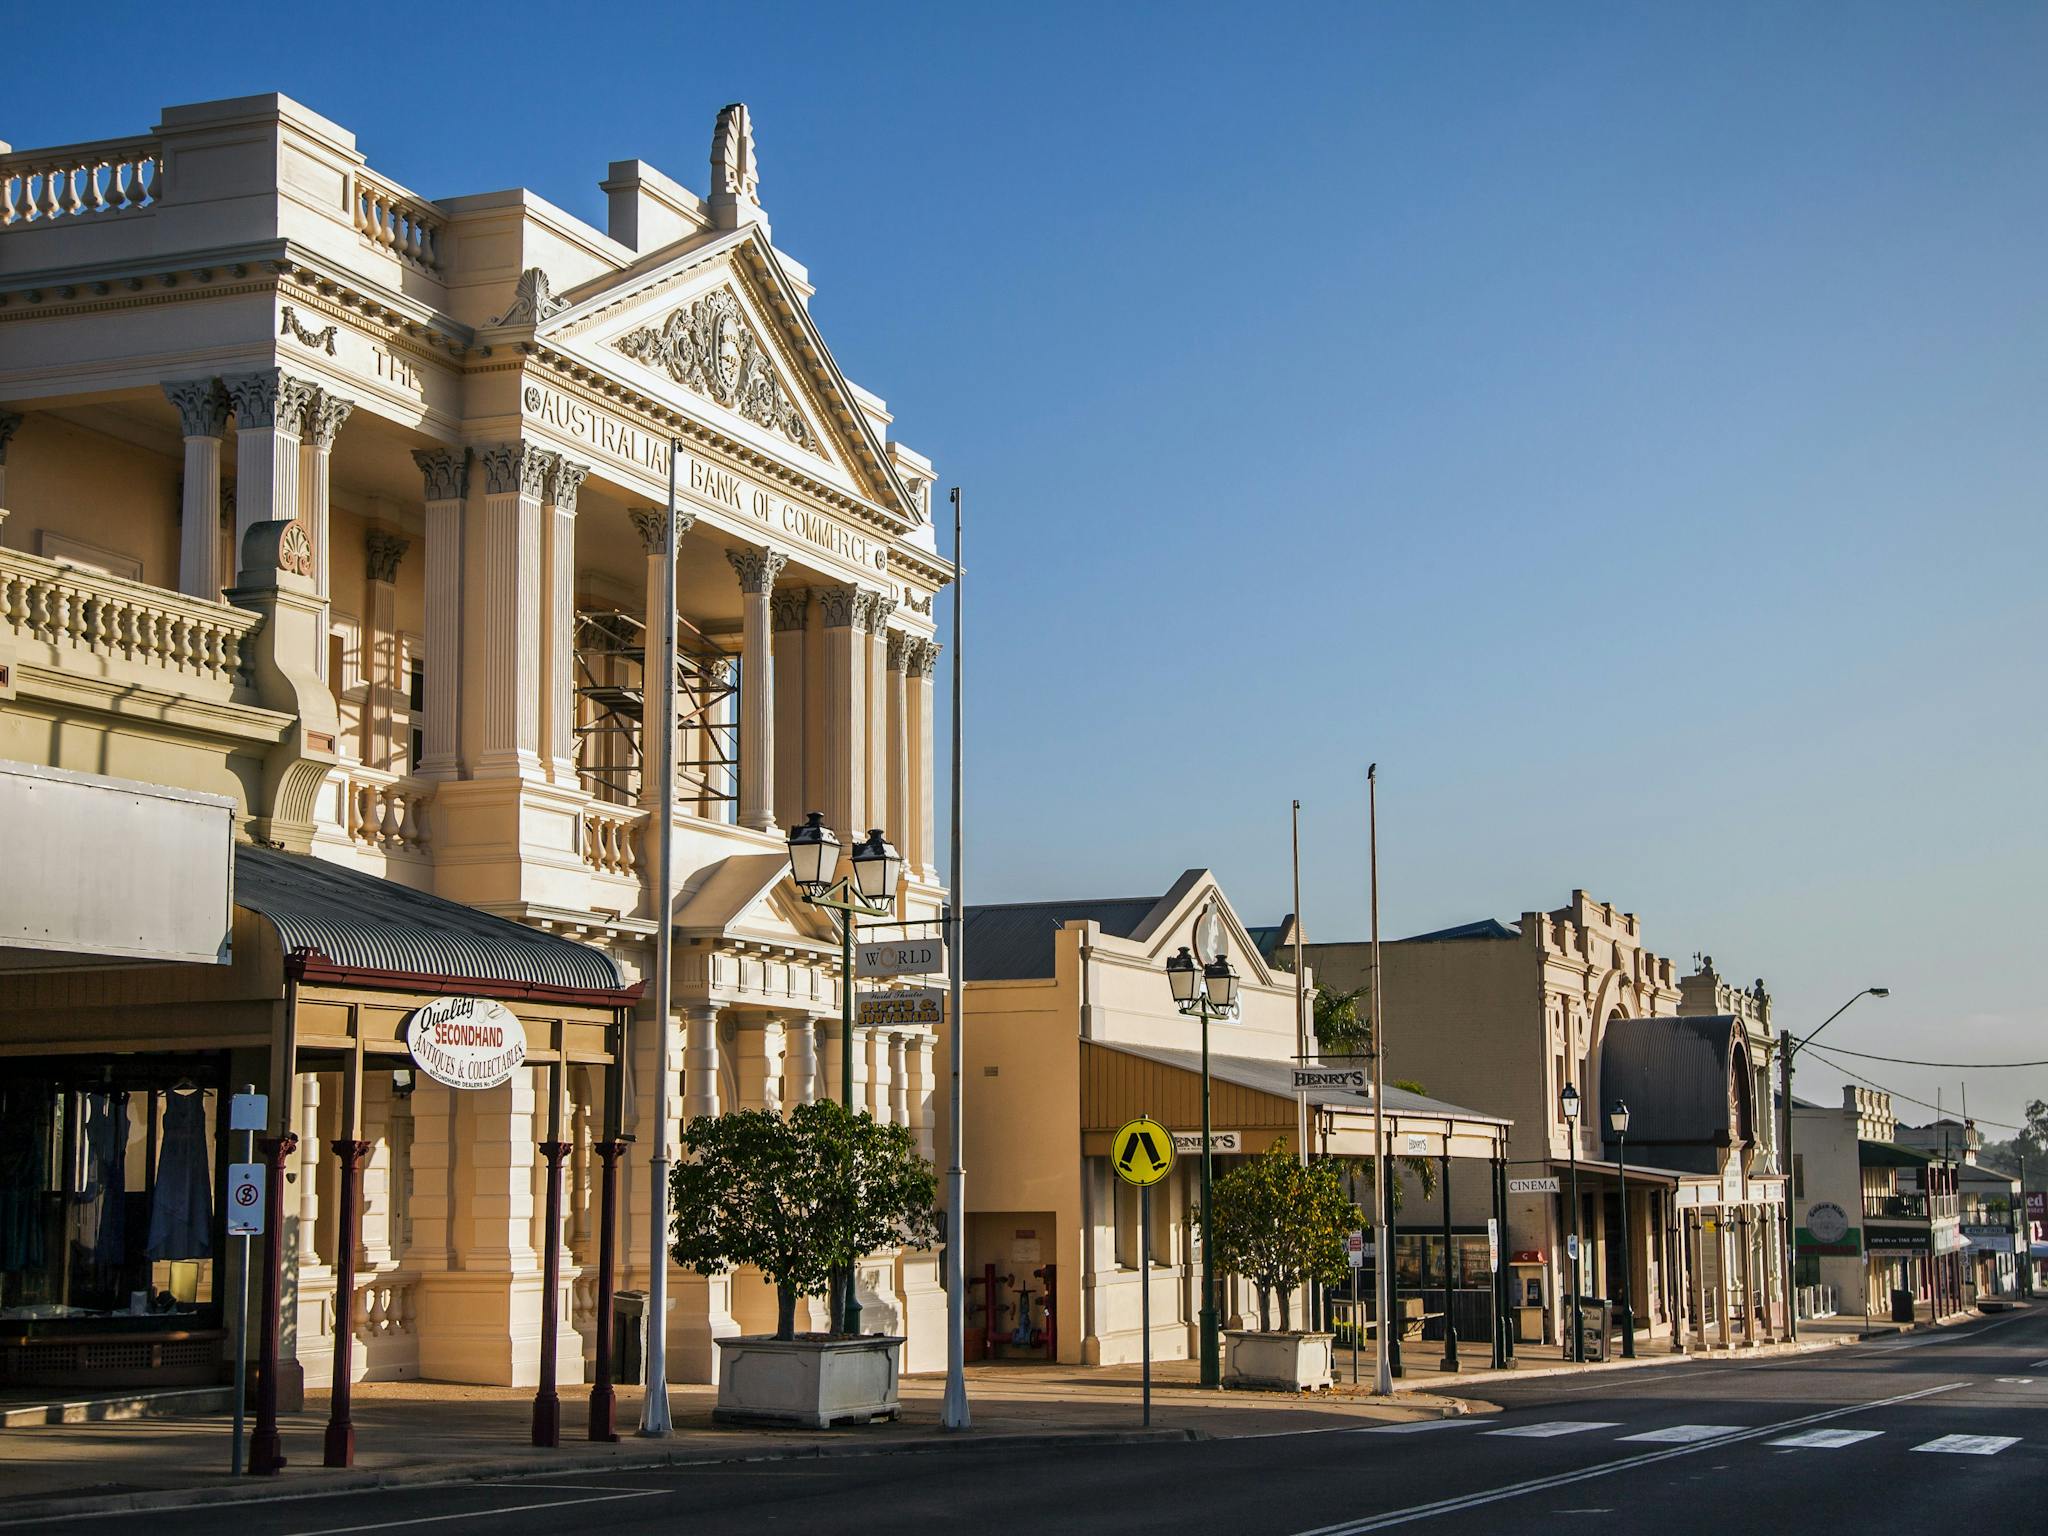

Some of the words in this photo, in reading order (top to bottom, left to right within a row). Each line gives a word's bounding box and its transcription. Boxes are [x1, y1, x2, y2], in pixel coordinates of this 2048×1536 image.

[370, 345, 424, 392] THE
[540, 390, 672, 476] AUSTRALIAN
[690, 459, 742, 510] BANK
[753, 489, 776, 522] OF
[783, 503, 873, 569] COMMERCE
[865, 947, 932, 968] WORLD
[420, 997, 475, 1034] Quality
[860, 1000, 915, 1014] GIFTS
[919, 998, 937, 1011] &
[857, 1010, 940, 1024] SOUVENIRS
[435, 1023, 503, 1048] SECONDHAND
[414, 1034, 456, 1076] ANTIQUES
[458, 1060, 465, 1079] &
[468, 1040, 523, 1080] COLLECTABLES
[429, 1069, 461, 1087] SECONDHAND
[462, 1080, 483, 1088] DEALERS
[1294, 1071, 1364, 1087] HENRY'S
[1509, 1180, 1557, 1192] CINEMA
